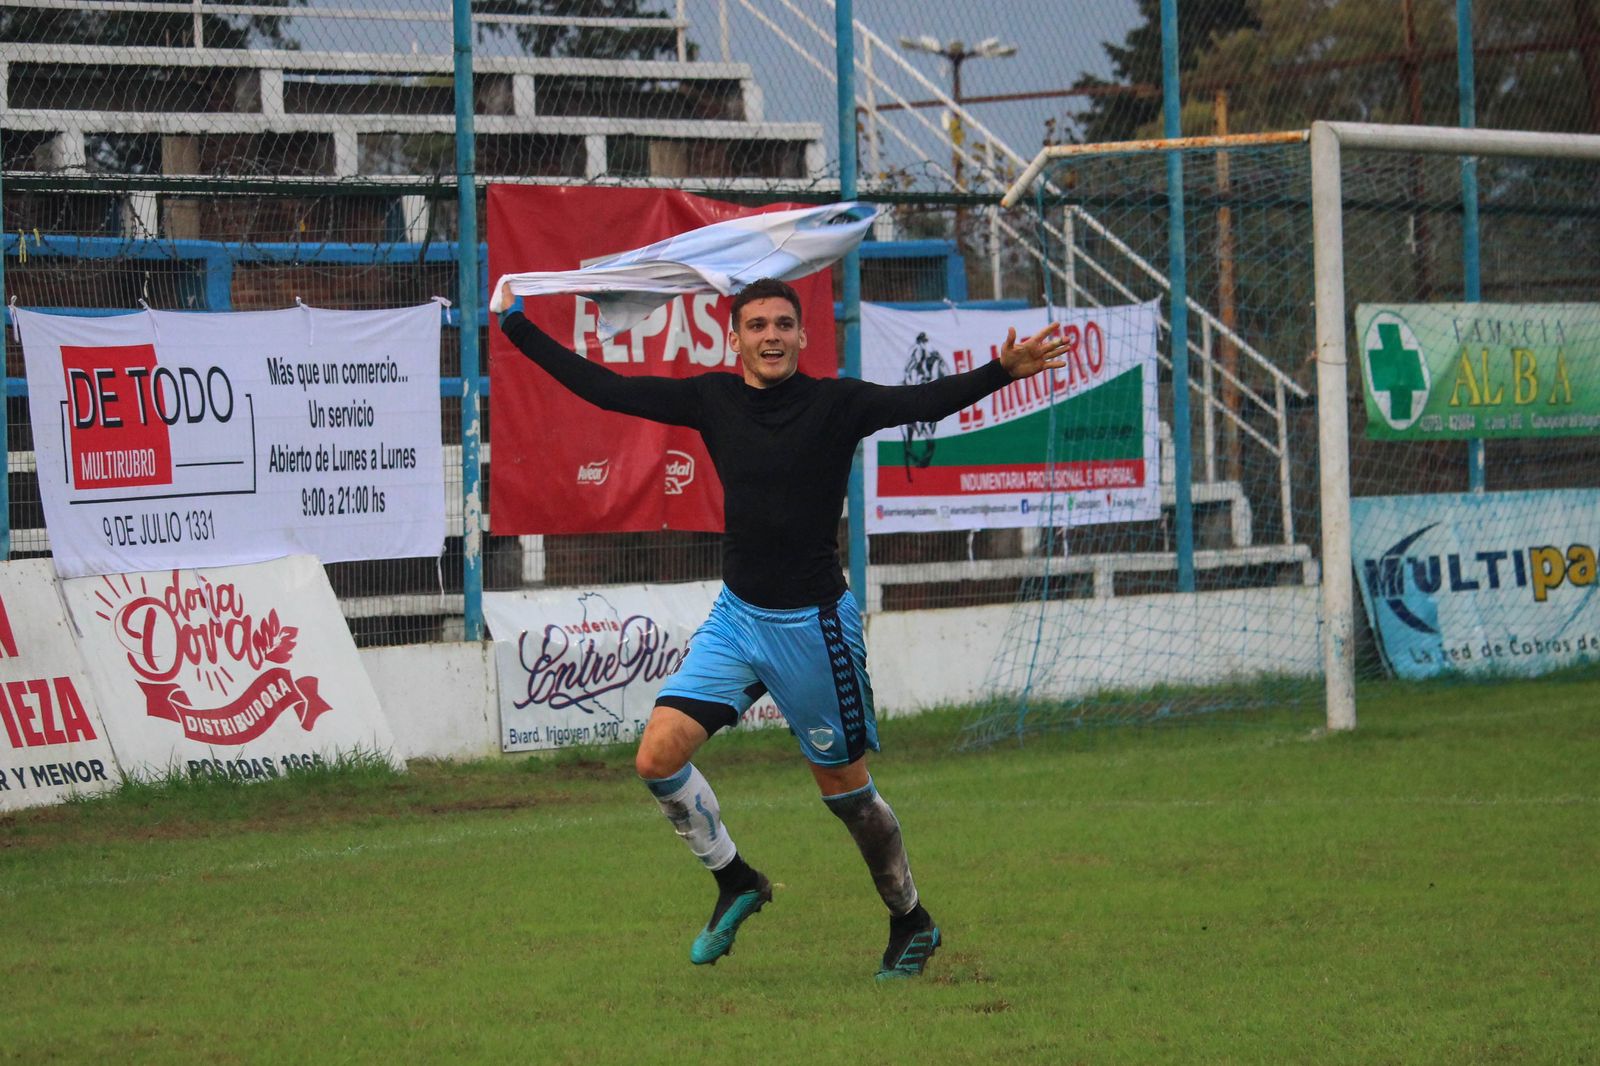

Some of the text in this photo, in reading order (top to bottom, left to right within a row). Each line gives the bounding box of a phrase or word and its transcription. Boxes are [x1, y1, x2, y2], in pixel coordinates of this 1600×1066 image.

[573, 293, 737, 367] FPAS
[267, 356, 409, 392] Más que un comercio...
[954, 349, 984, 430] EL
[1448, 346, 1572, 407] ALBA
[67, 364, 235, 430] DE TODO
[309, 400, 375, 428] Un servicio
[81, 447, 156, 481] MULTIRUBRO
[269, 440, 417, 473] Abierto de Lunes a Lunes
[960, 472, 1026, 491] INDUMENTARIA
[302, 485, 386, 516] 9:00 a 21:00 hs
[103, 510, 215, 546] 9 DE JULIO 1331
[1364, 543, 1600, 602] MULTIpa
[513, 624, 619, 709] Entre
[1409, 647, 1433, 665] La
[1481, 642, 1503, 658] de
[1509, 637, 1571, 656] Cobros
[185, 677, 293, 735] DISTRIBUIDORA
[509, 727, 543, 746] Bvard.
[546, 724, 590, 746] Irigoyen
[592, 721, 618, 738] 1370
[10, 767, 27, 790] Y
[30, 759, 108, 788] MENOR
[187, 756, 279, 780] POSADAS
